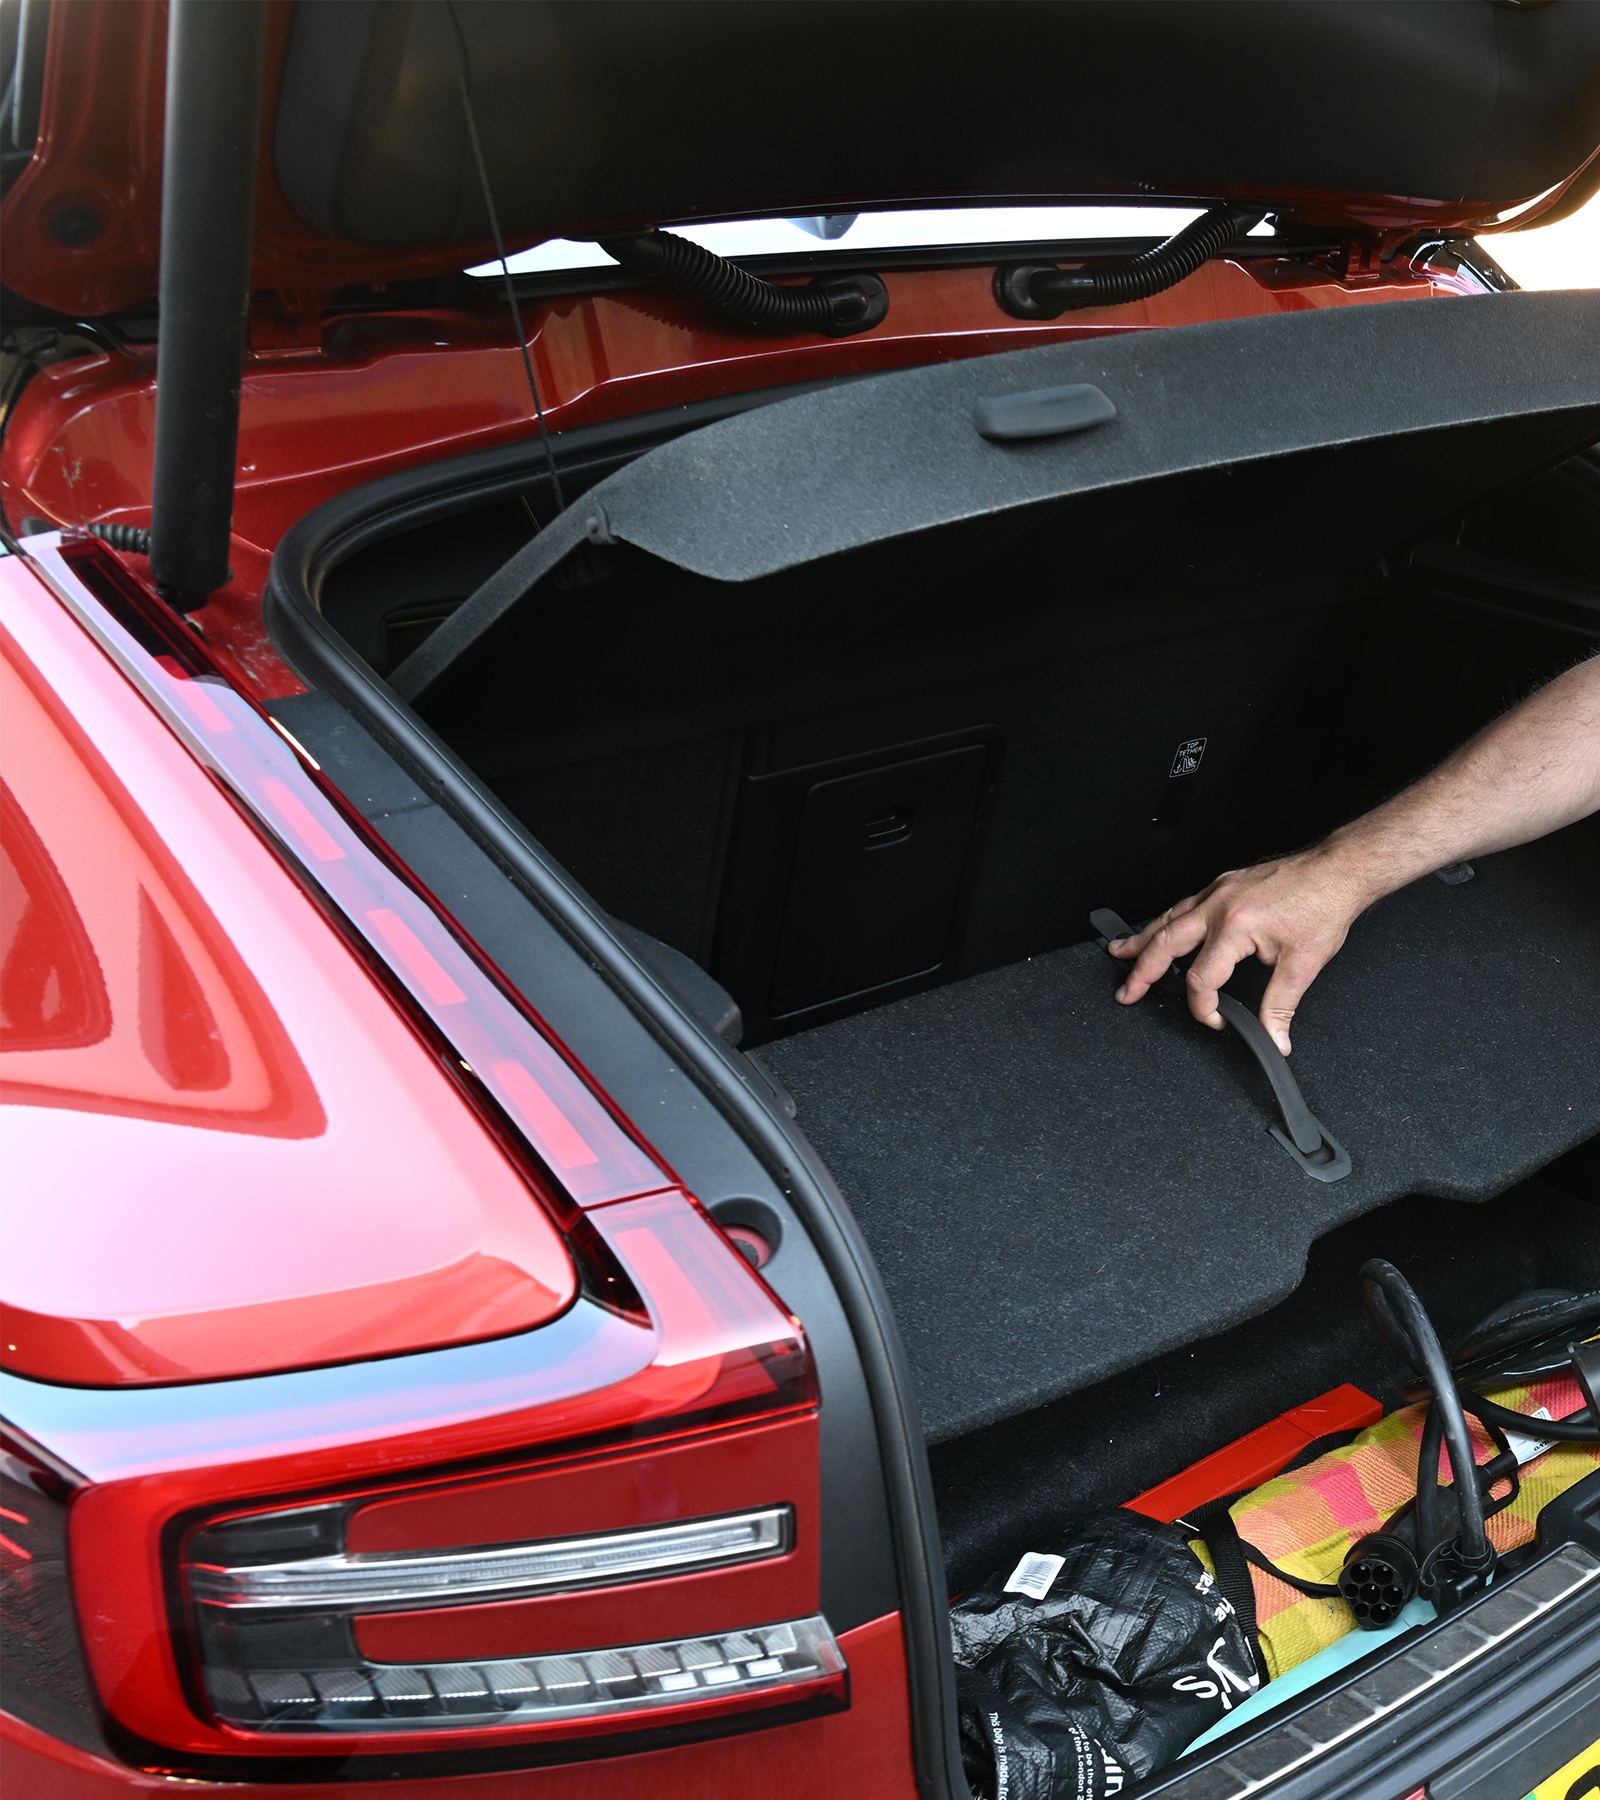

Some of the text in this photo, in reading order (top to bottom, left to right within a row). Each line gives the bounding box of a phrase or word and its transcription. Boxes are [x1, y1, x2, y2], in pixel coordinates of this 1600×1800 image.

[1179, 745, 1203, 757] TETHER
[1187, 741, 1199, 749] TOP
[988, 1711, 1000, 1727] This
[993, 1727, 1004, 1745] bag
[1068, 1726, 1080, 1736] of
[997, 1745, 1007, 1754] is
[1073, 1736, 1082, 1753] the
[1083, 1741, 1090, 1752] to
[1085, 1753, 1093, 1766] be
[999, 1755, 1010, 1785] made
[1077, 1754, 1086, 1793] London
[1087, 1768, 1095, 1785] the
